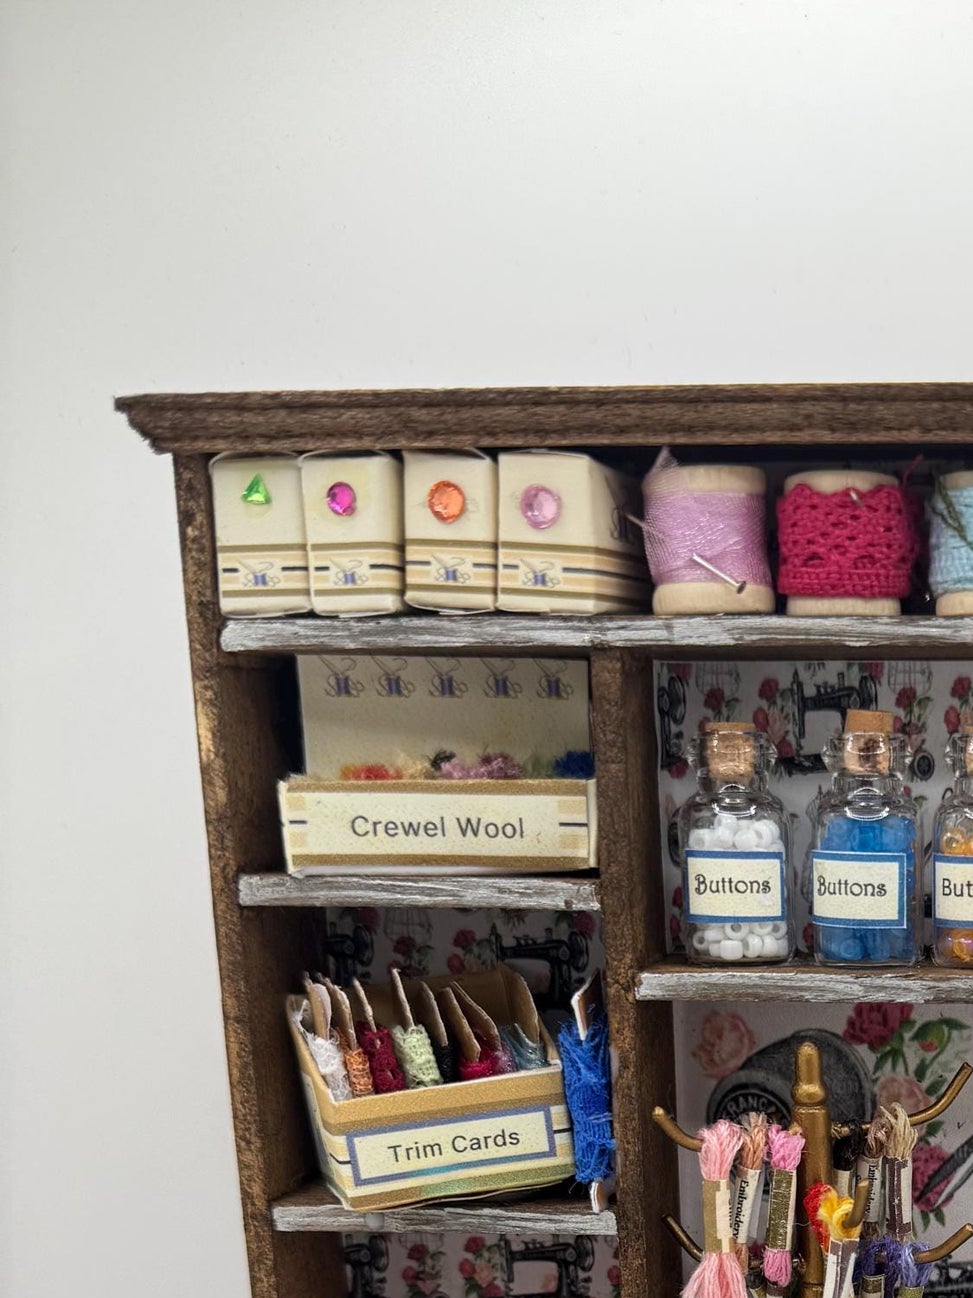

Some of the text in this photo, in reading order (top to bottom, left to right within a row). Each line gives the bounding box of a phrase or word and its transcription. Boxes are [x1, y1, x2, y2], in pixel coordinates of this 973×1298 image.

[350, 815, 525, 840] Crewel Wool
[694, 873, 772, 896] Buttons
[817, 875, 888, 897] Buttons
[387, 1128, 521, 1164] Trim Cards
[733, 1179, 749, 1239] Embroidery
